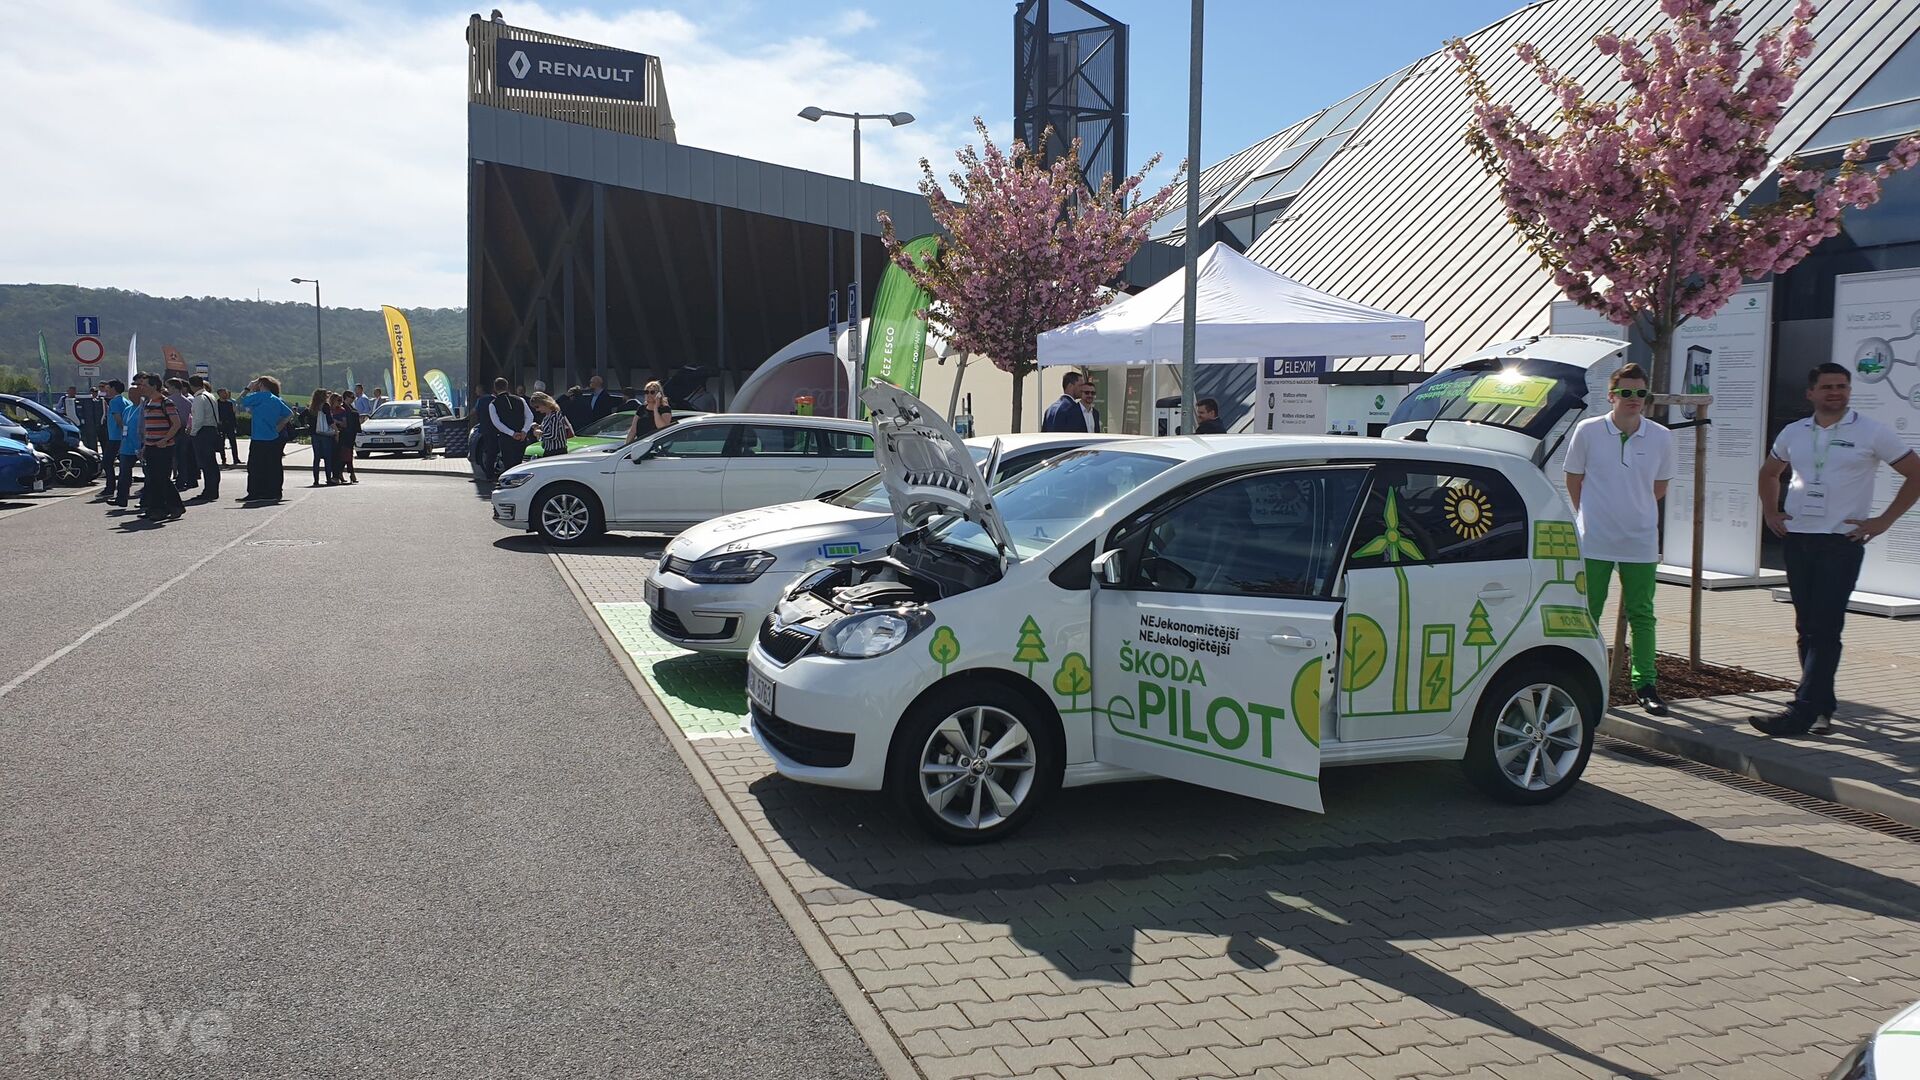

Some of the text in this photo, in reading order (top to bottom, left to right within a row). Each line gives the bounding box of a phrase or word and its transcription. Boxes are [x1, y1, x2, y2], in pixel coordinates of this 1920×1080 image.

[538, 60, 634, 83] RENAULT
[1867, 311, 1892, 321] 2035
[881, 327, 894, 376] ČEZ ESCO
[1284, 360, 1316, 374] ELEXIM
[1140, 613, 1240, 640] NEJekonomičtější
[1139, 629, 1230, 657] NEJekologičtější
[1119, 640, 1207, 687] ŠKODA
